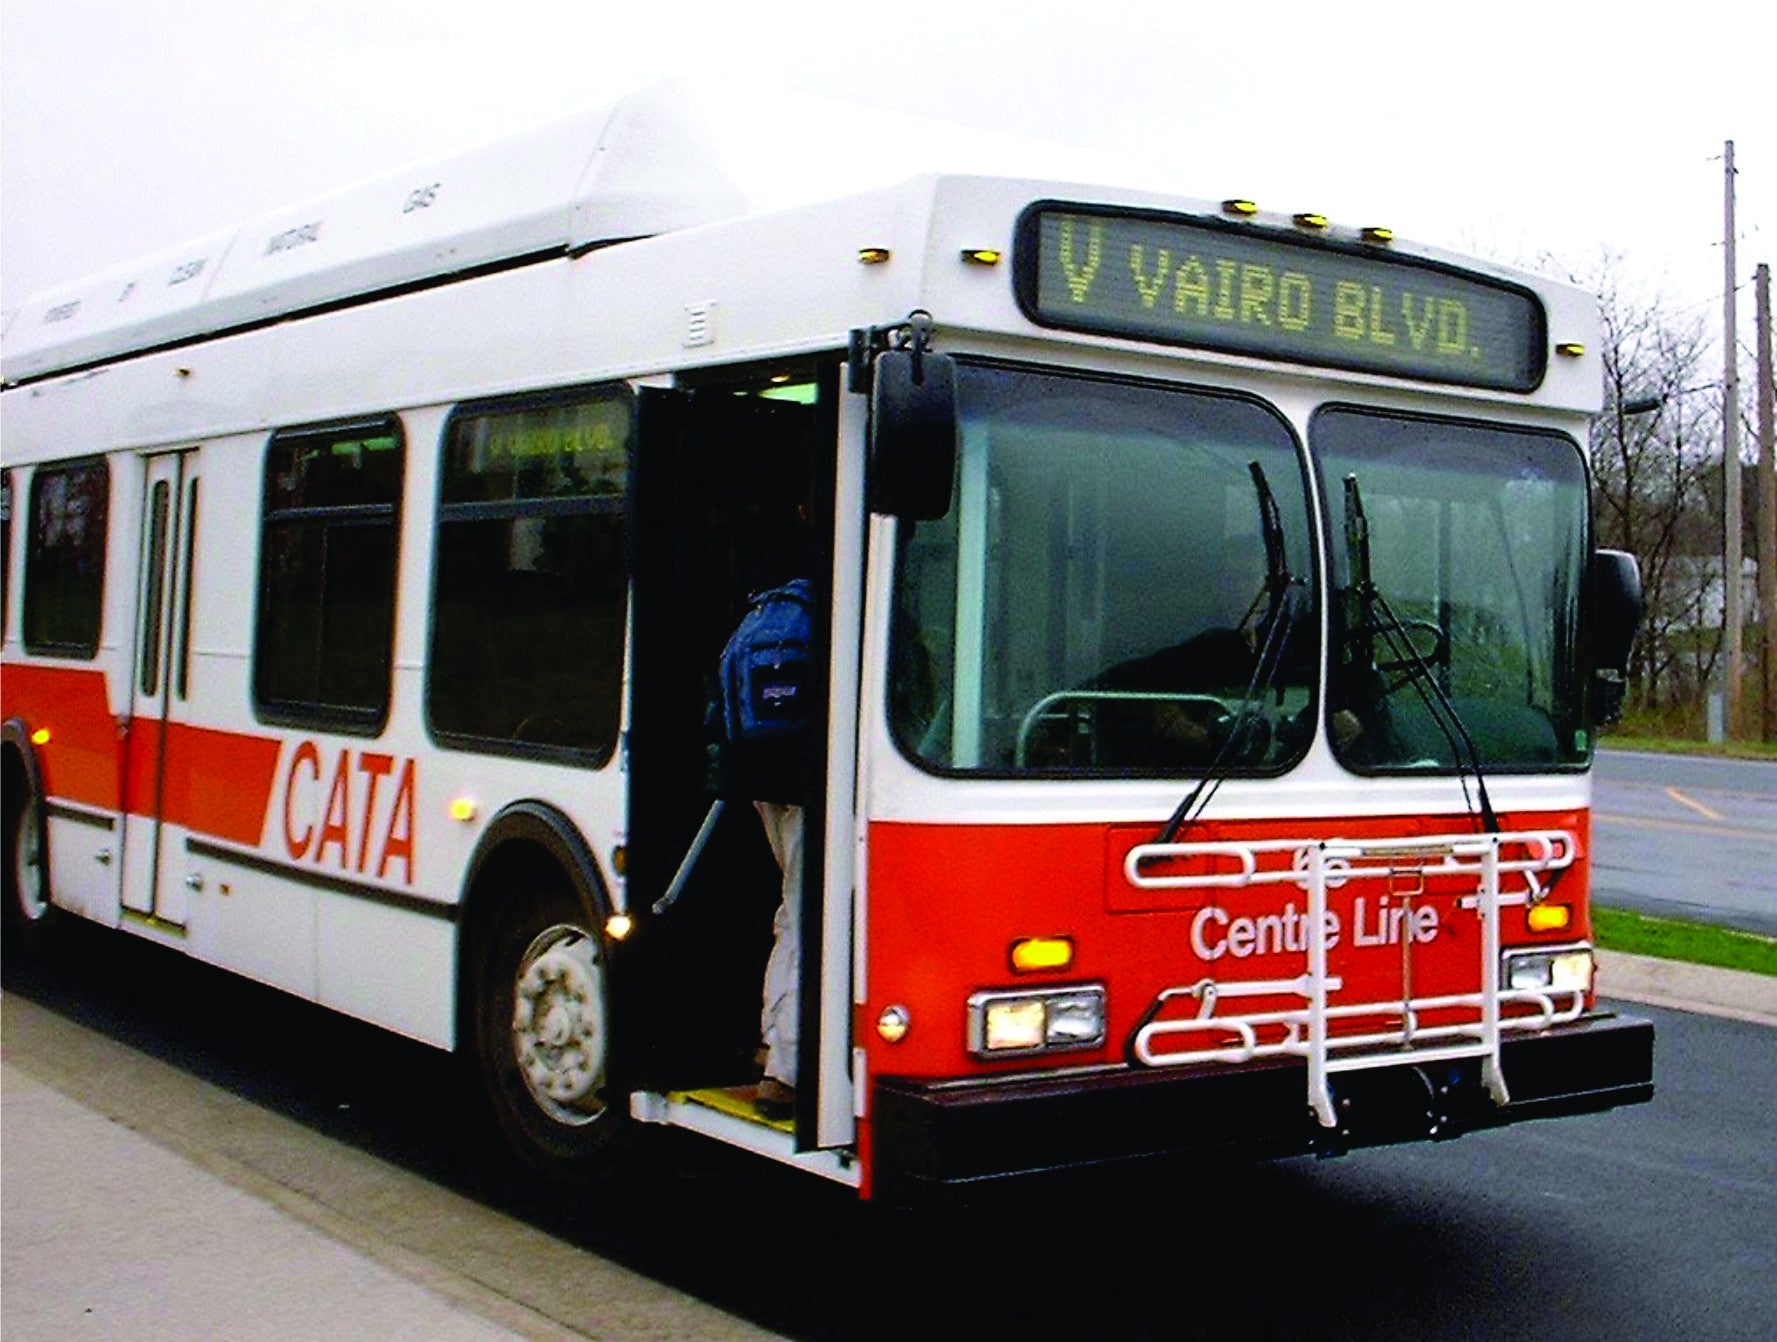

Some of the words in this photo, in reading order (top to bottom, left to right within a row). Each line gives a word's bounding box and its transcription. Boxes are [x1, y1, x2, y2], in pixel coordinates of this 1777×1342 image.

[1059, 217, 1100, 303] V
[1129, 242, 1312, 331] VAIRO
[1333, 278, 1482, 362] BLVD.
[284, 740, 416, 885] CATA
[1190, 902, 1341, 961] Centre
[1353, 896, 1439, 947] Line
